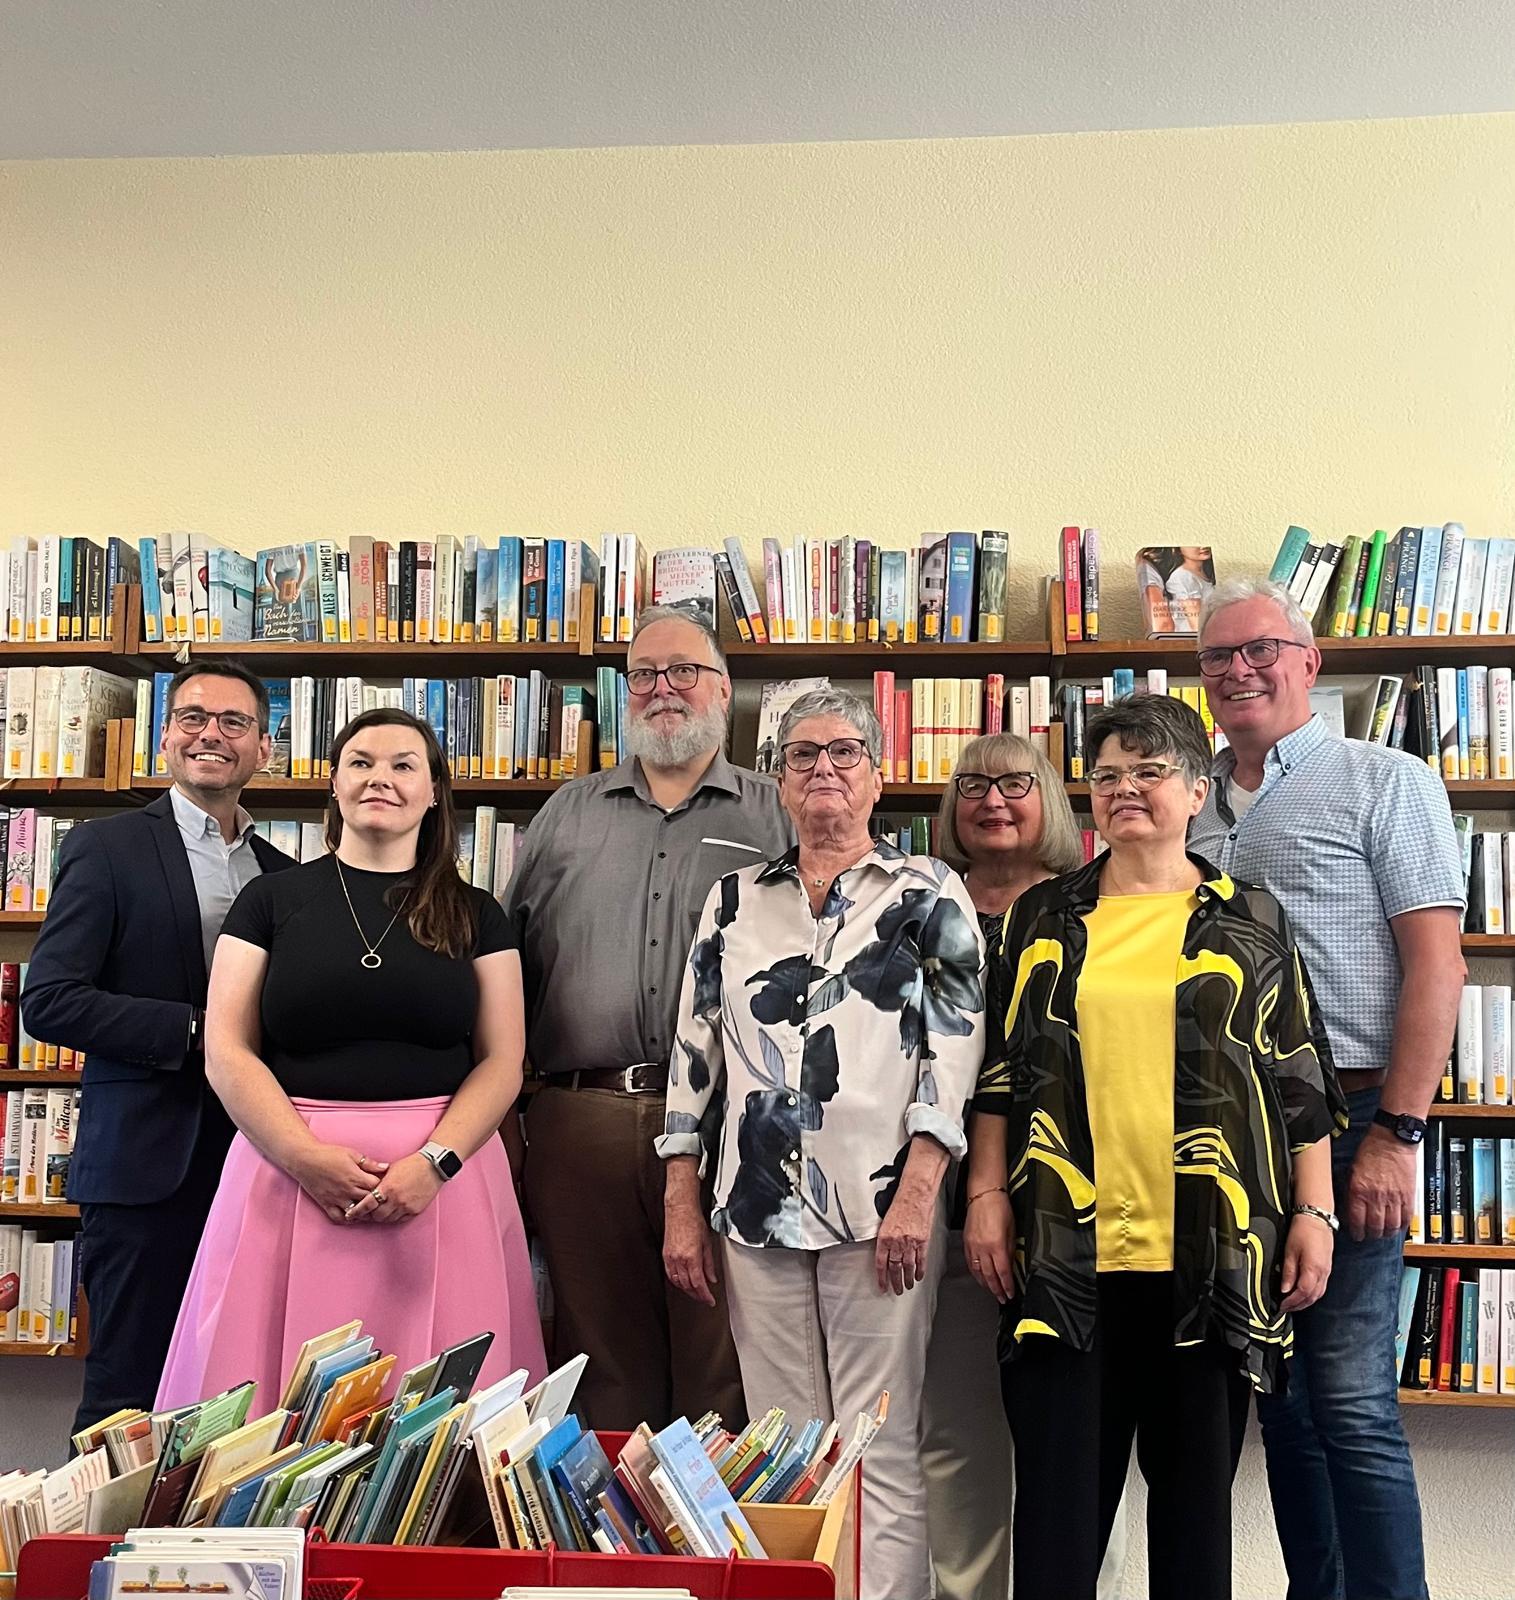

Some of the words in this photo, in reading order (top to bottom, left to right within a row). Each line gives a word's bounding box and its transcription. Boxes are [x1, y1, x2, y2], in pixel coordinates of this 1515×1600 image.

[319, 544, 334, 582] SCHWEIGT
[1088, 534, 1097, 581] Cascadia
[1310, 548, 1320, 565] PIPER
[1331, 548, 1340, 565] PIPER
[1400, 541, 1410, 577] PRANGE
[1408, 546, 1417, 573] PETER
[1421, 541, 1431, 577] PRANGE
[1429, 545, 1438, 571] PETER
[1442, 533, 1454, 573] PRANGE
[1452, 538, 1461, 569] PETER
[361, 553, 369, 585] STORE
[321, 593, 336, 616] ALLES
[100, 685, 121, 704] KEN
[351, 683, 359, 710] Fluss
[416, 688, 426, 716] tschick
[1498, 709, 1507, 727] REID
[1499, 730, 1507, 752] KILEY
[15, 815, 27, 848] Minna
[11, 1096, 22, 1154] STURMVOGEL
[54, 1097, 72, 1144] Medicus
[525, 1489, 536, 1509] PETER
